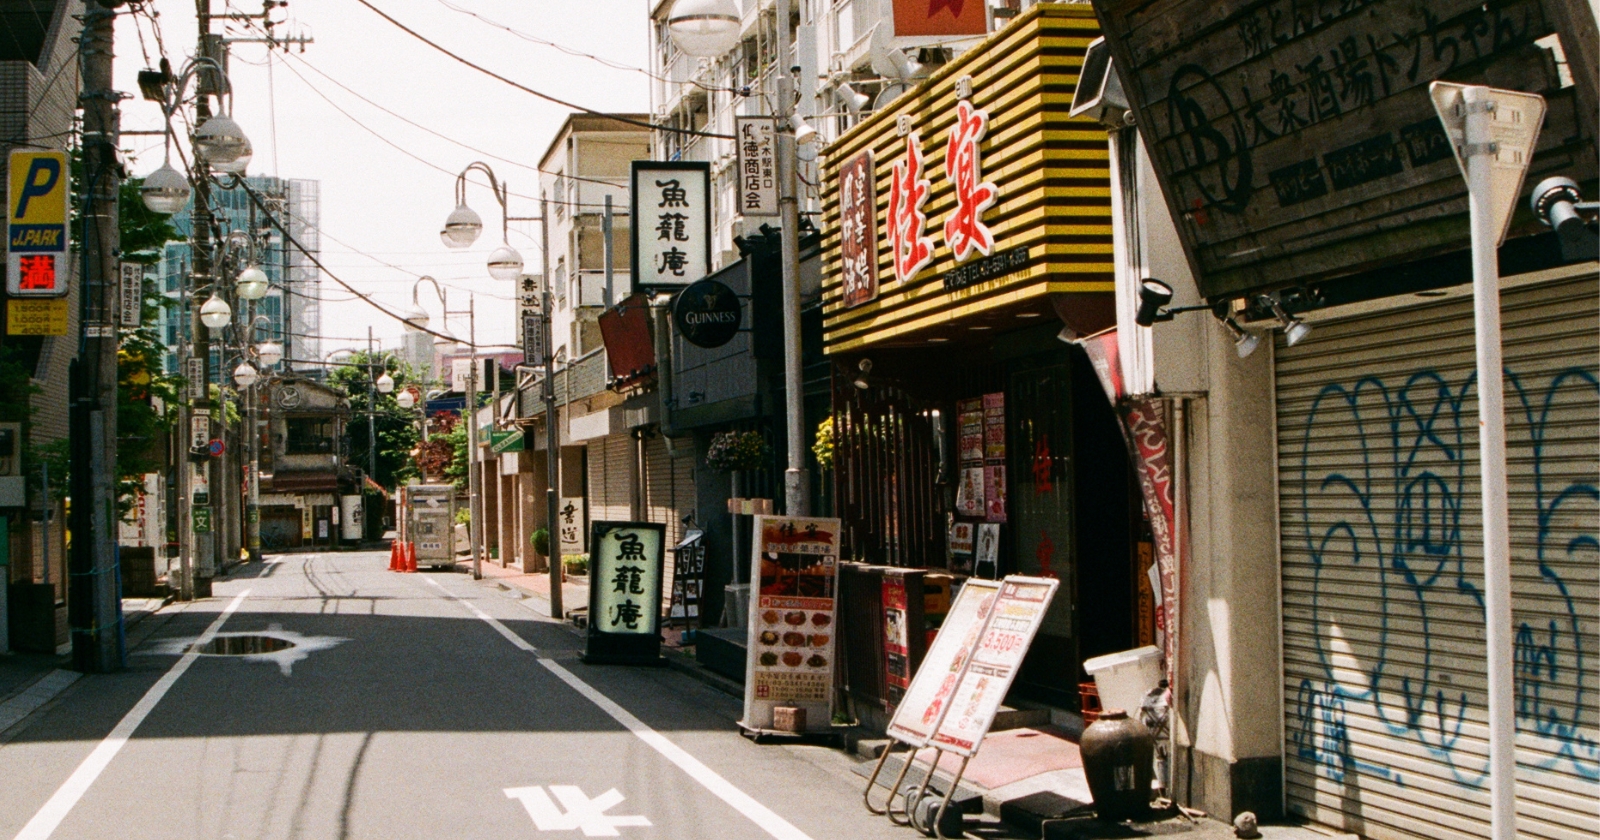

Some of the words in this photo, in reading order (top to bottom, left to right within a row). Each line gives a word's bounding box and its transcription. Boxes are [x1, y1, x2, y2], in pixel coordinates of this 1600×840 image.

[15, 158, 60, 218] P
[12, 230, 60, 246] J.PARK
[20, 255, 55, 289] 満
[685, 311, 736, 325] GUINNESS
[560, 501, 578, 544] 書道
